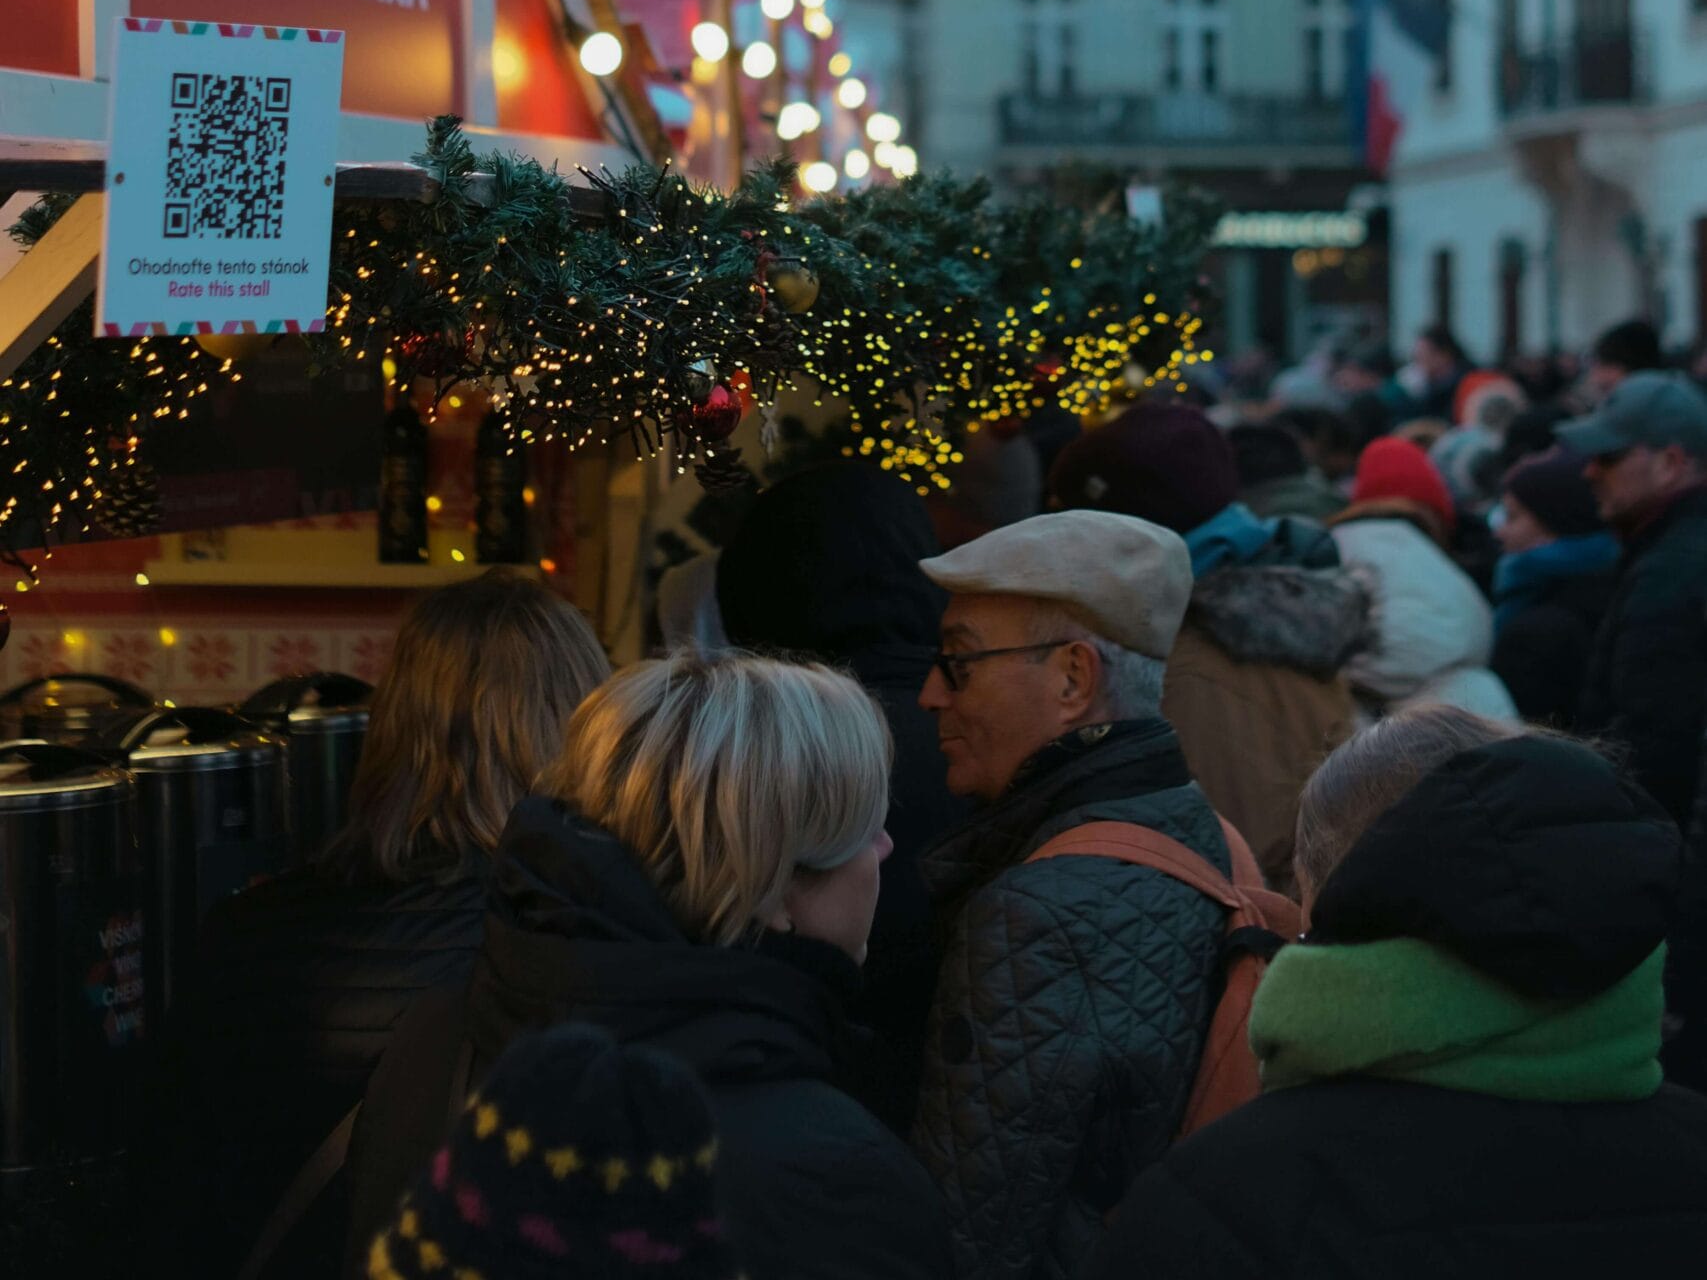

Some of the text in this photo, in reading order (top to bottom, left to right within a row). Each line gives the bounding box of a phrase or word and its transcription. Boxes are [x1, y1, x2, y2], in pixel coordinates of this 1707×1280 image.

[217, 258, 256, 275] tento
[261, 257, 310, 274] stánok
[168, 279, 271, 297] Rate this stall
